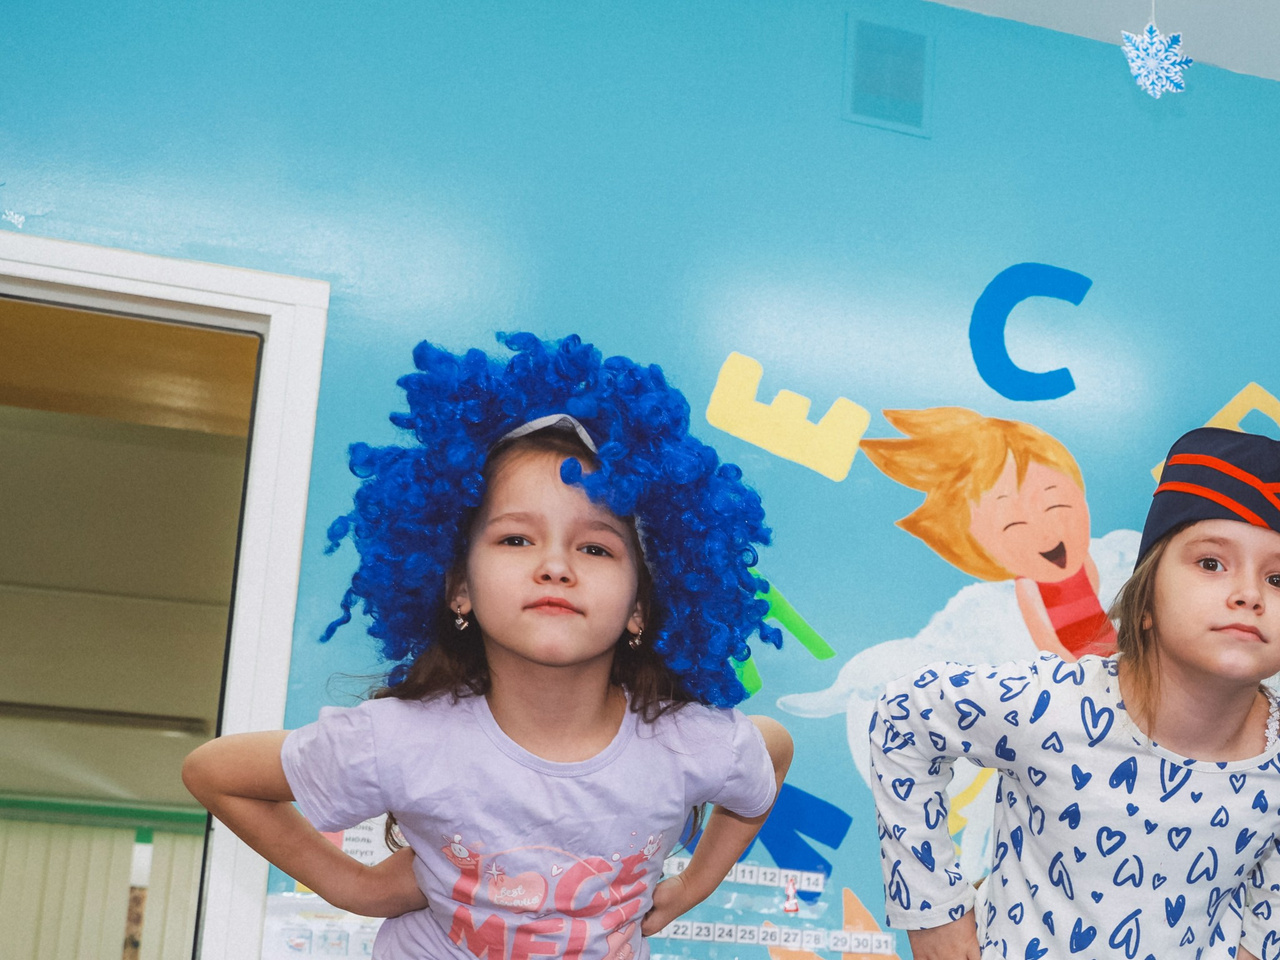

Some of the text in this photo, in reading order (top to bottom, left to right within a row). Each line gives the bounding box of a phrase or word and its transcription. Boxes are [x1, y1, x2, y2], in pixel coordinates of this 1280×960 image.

[741, 869, 754, 880] 11
[762, 871, 777, 883] 12
[806, 876, 820, 888] 14
[673, 924, 890, 950] 22 23 24 25 26 27 28 29 30 31
